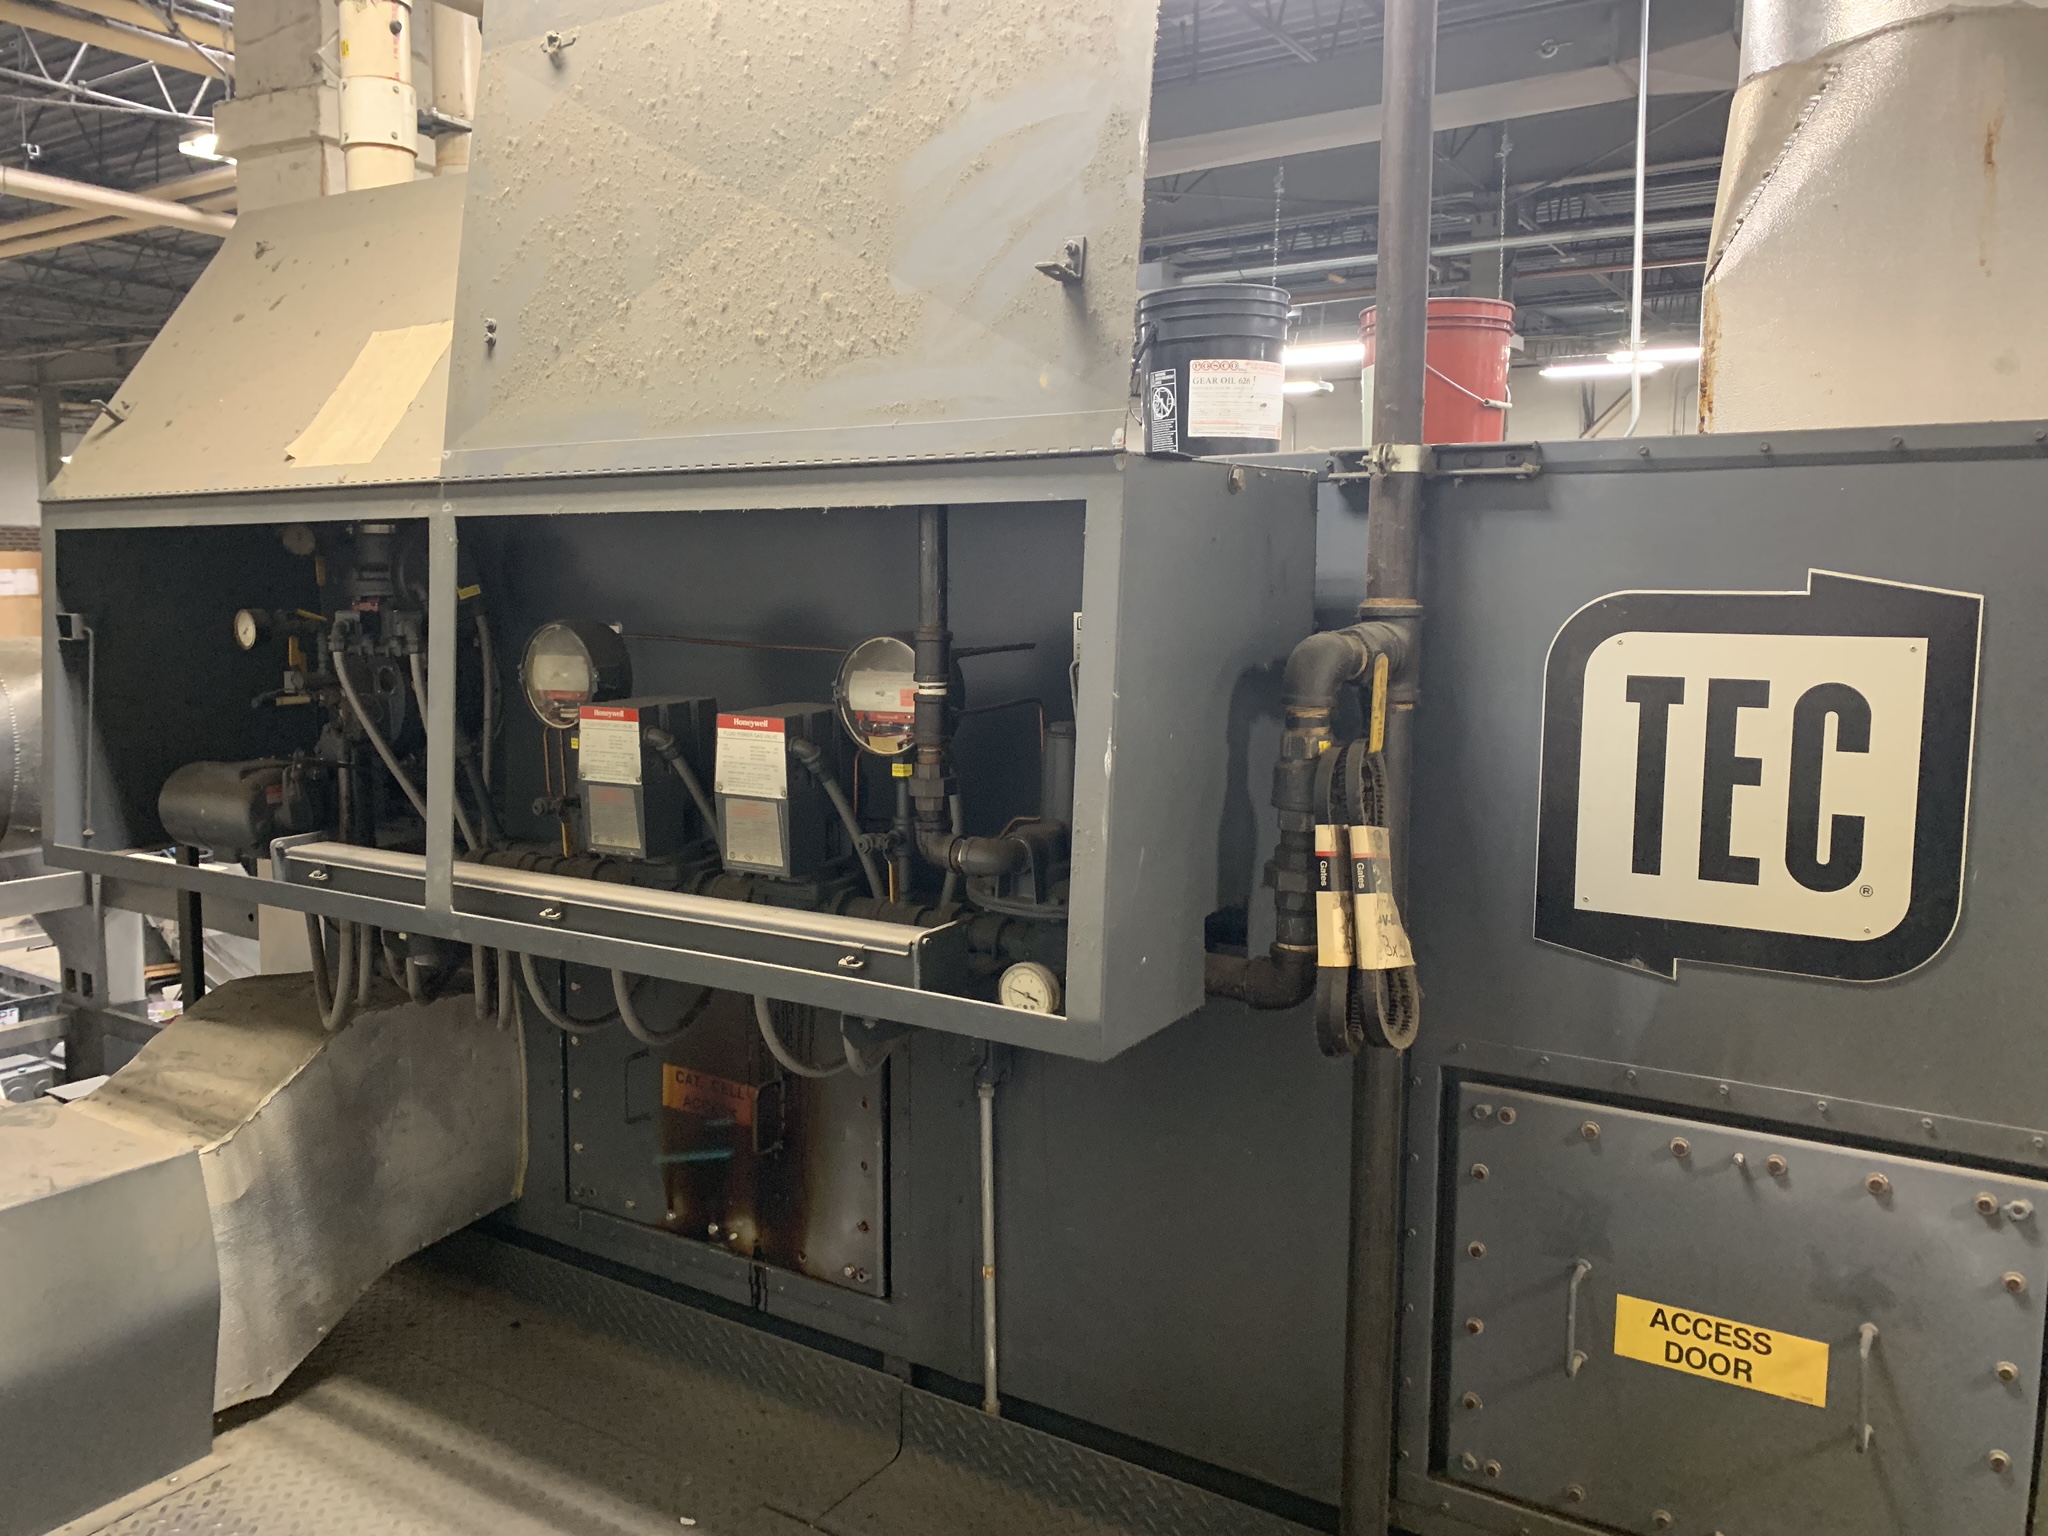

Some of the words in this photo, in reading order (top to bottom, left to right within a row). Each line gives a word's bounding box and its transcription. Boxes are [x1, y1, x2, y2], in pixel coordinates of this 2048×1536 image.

[1192, 377, 1219, 385] GEAR
[1220, 377, 1236, 385] OIL
[1238, 377, 1251, 385] 626
[593, 709, 625, 718] Honeywell
[733, 718, 769, 728] Honeywell
[1626, 675, 1872, 893] TEC
[1320, 860, 1328, 887] Gates
[1356, 862, 1365, 889] Gates
[1649, 1307, 1773, 1356] ACCESS
[1664, 1340, 1754, 1384] DOOR
